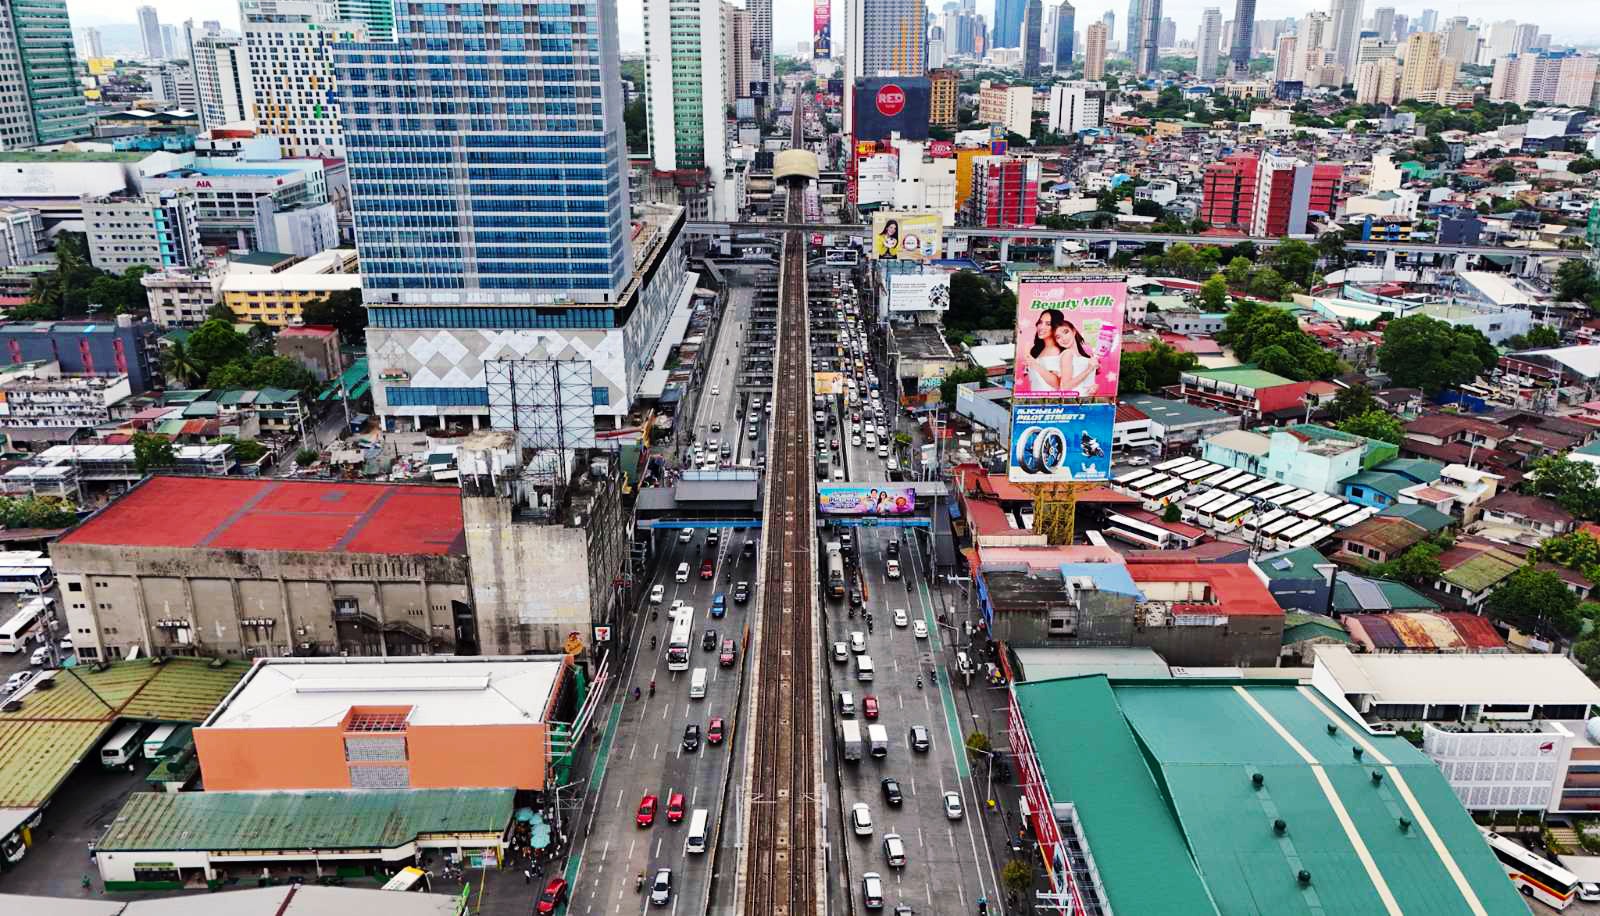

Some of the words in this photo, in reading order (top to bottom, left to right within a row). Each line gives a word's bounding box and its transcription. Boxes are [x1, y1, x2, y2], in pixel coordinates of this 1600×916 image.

[879, 93, 904, 103] RED
[1031, 299, 1079, 309] Beauty
[1082, 296, 1114, 306] Milk
